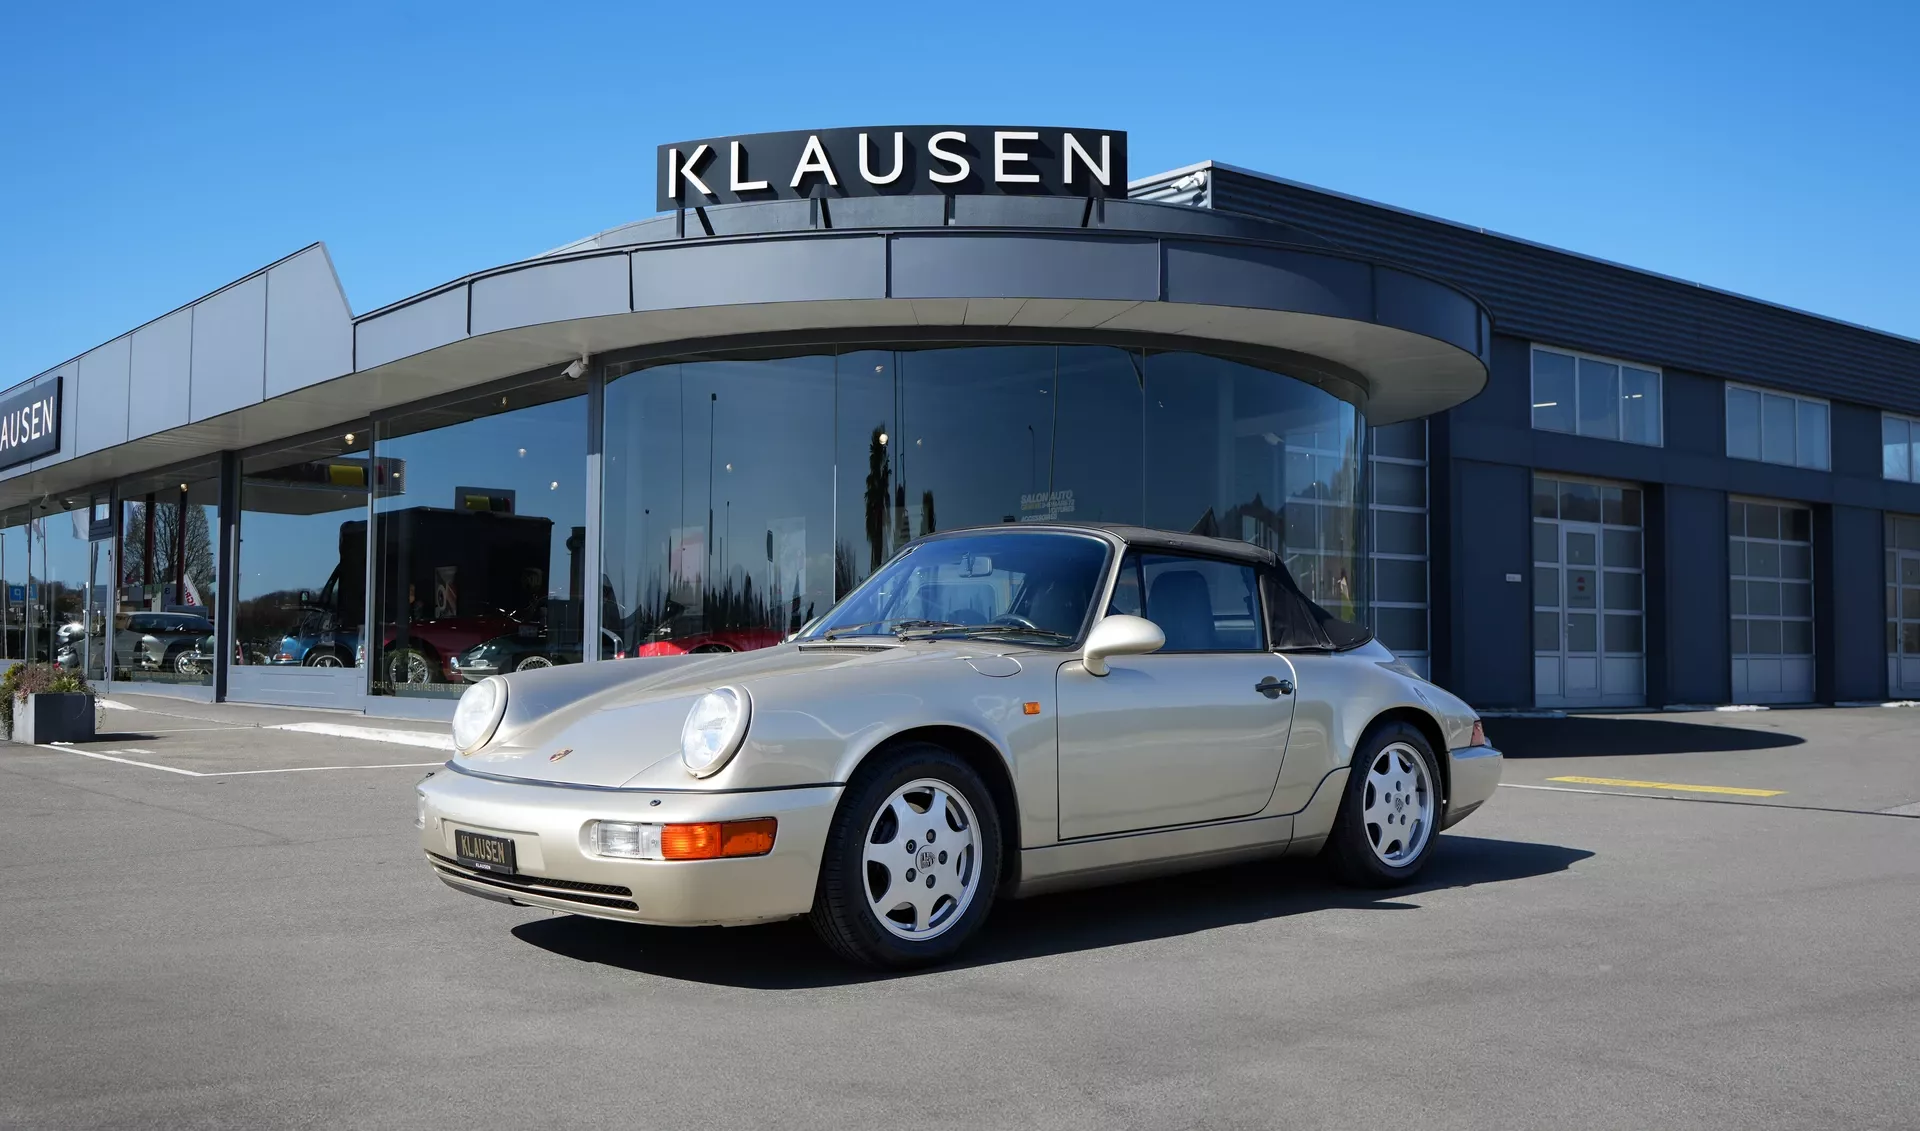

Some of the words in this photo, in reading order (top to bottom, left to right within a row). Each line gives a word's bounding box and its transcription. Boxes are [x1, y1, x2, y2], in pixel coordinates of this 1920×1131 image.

[668, 131, 1111, 198] KLAUSEN
[1021, 492, 1049, 504] SALON
[1050, 490, 1073, 501] AUTO
[392, 682, 409, 690] VENTE
[413, 683, 444, 692] ENTRETIEN
[461, 835, 505, 863] KLAUSEN
